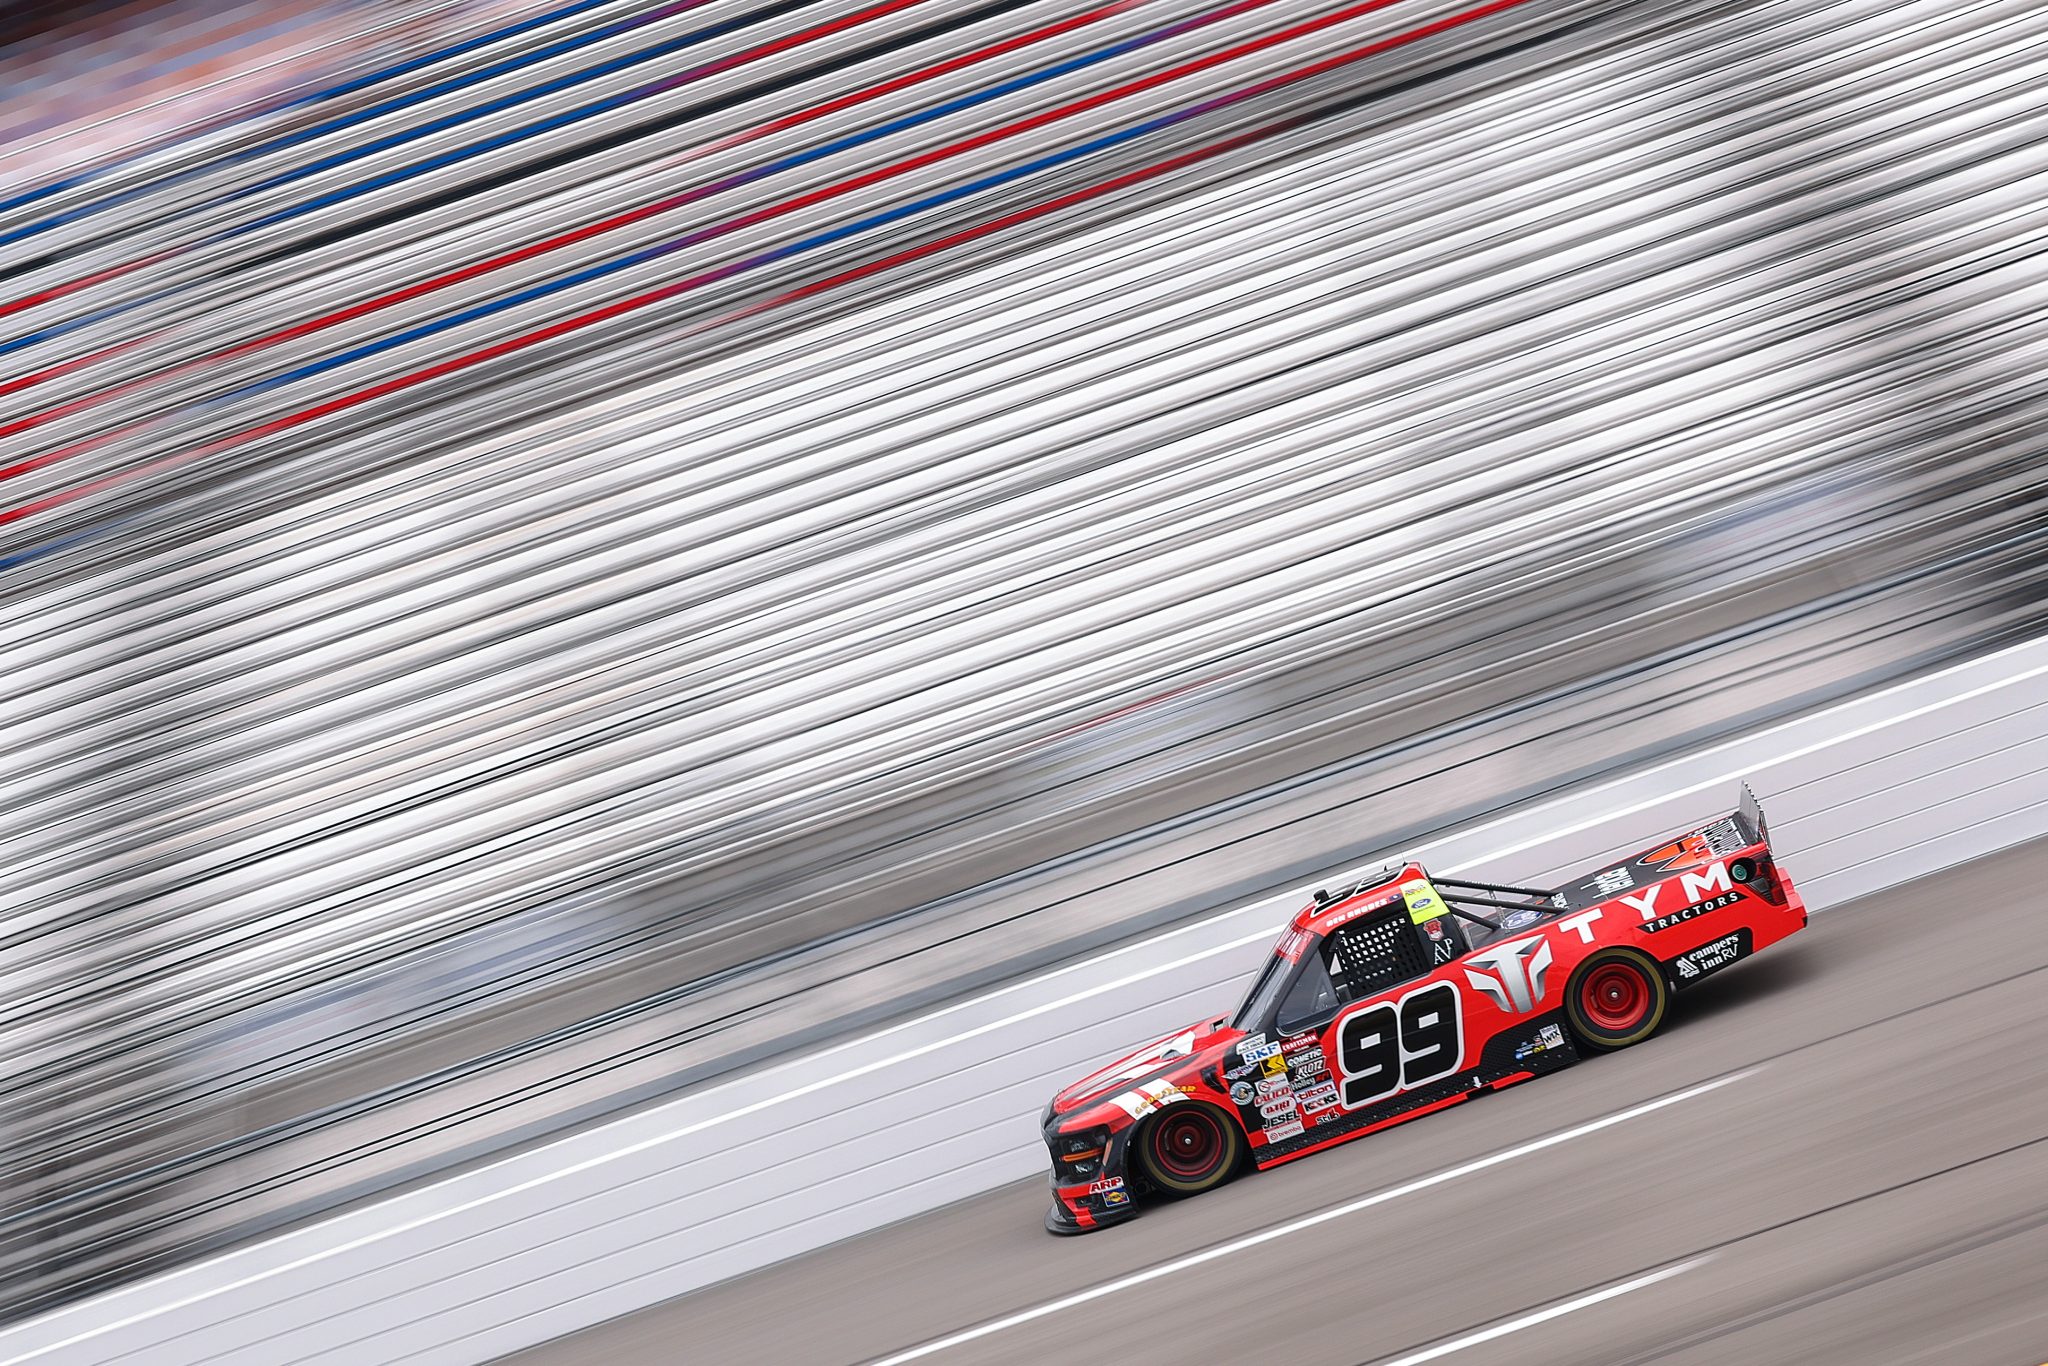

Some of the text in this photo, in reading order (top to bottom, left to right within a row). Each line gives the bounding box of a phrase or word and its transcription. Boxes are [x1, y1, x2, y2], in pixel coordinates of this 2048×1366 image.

[1557, 860, 1733, 945] TYM
[1645, 892, 1739, 932] TRACTORS
[1325, 914, 1346, 928] BEN
[1688, 933, 1739, 962] campers
[1700, 944, 1738, 970] inn RV
[1336, 979, 1465, 1111] 99
[1543, 1030, 1560, 1045] WIX
[1245, 1043, 1278, 1063] SKF
[1287, 1048, 1323, 1068] COMETIC
[1297, 1059, 1324, 1081] KLOTZ
[1134, 1085, 1197, 1115] GOODYEAR
[1297, 1084, 1333, 1101] tilton
[1263, 1110, 1300, 1129] JESEL
[1277, 1125, 1302, 1137] brembo
[1090, 1177, 1122, 1193] ARP
